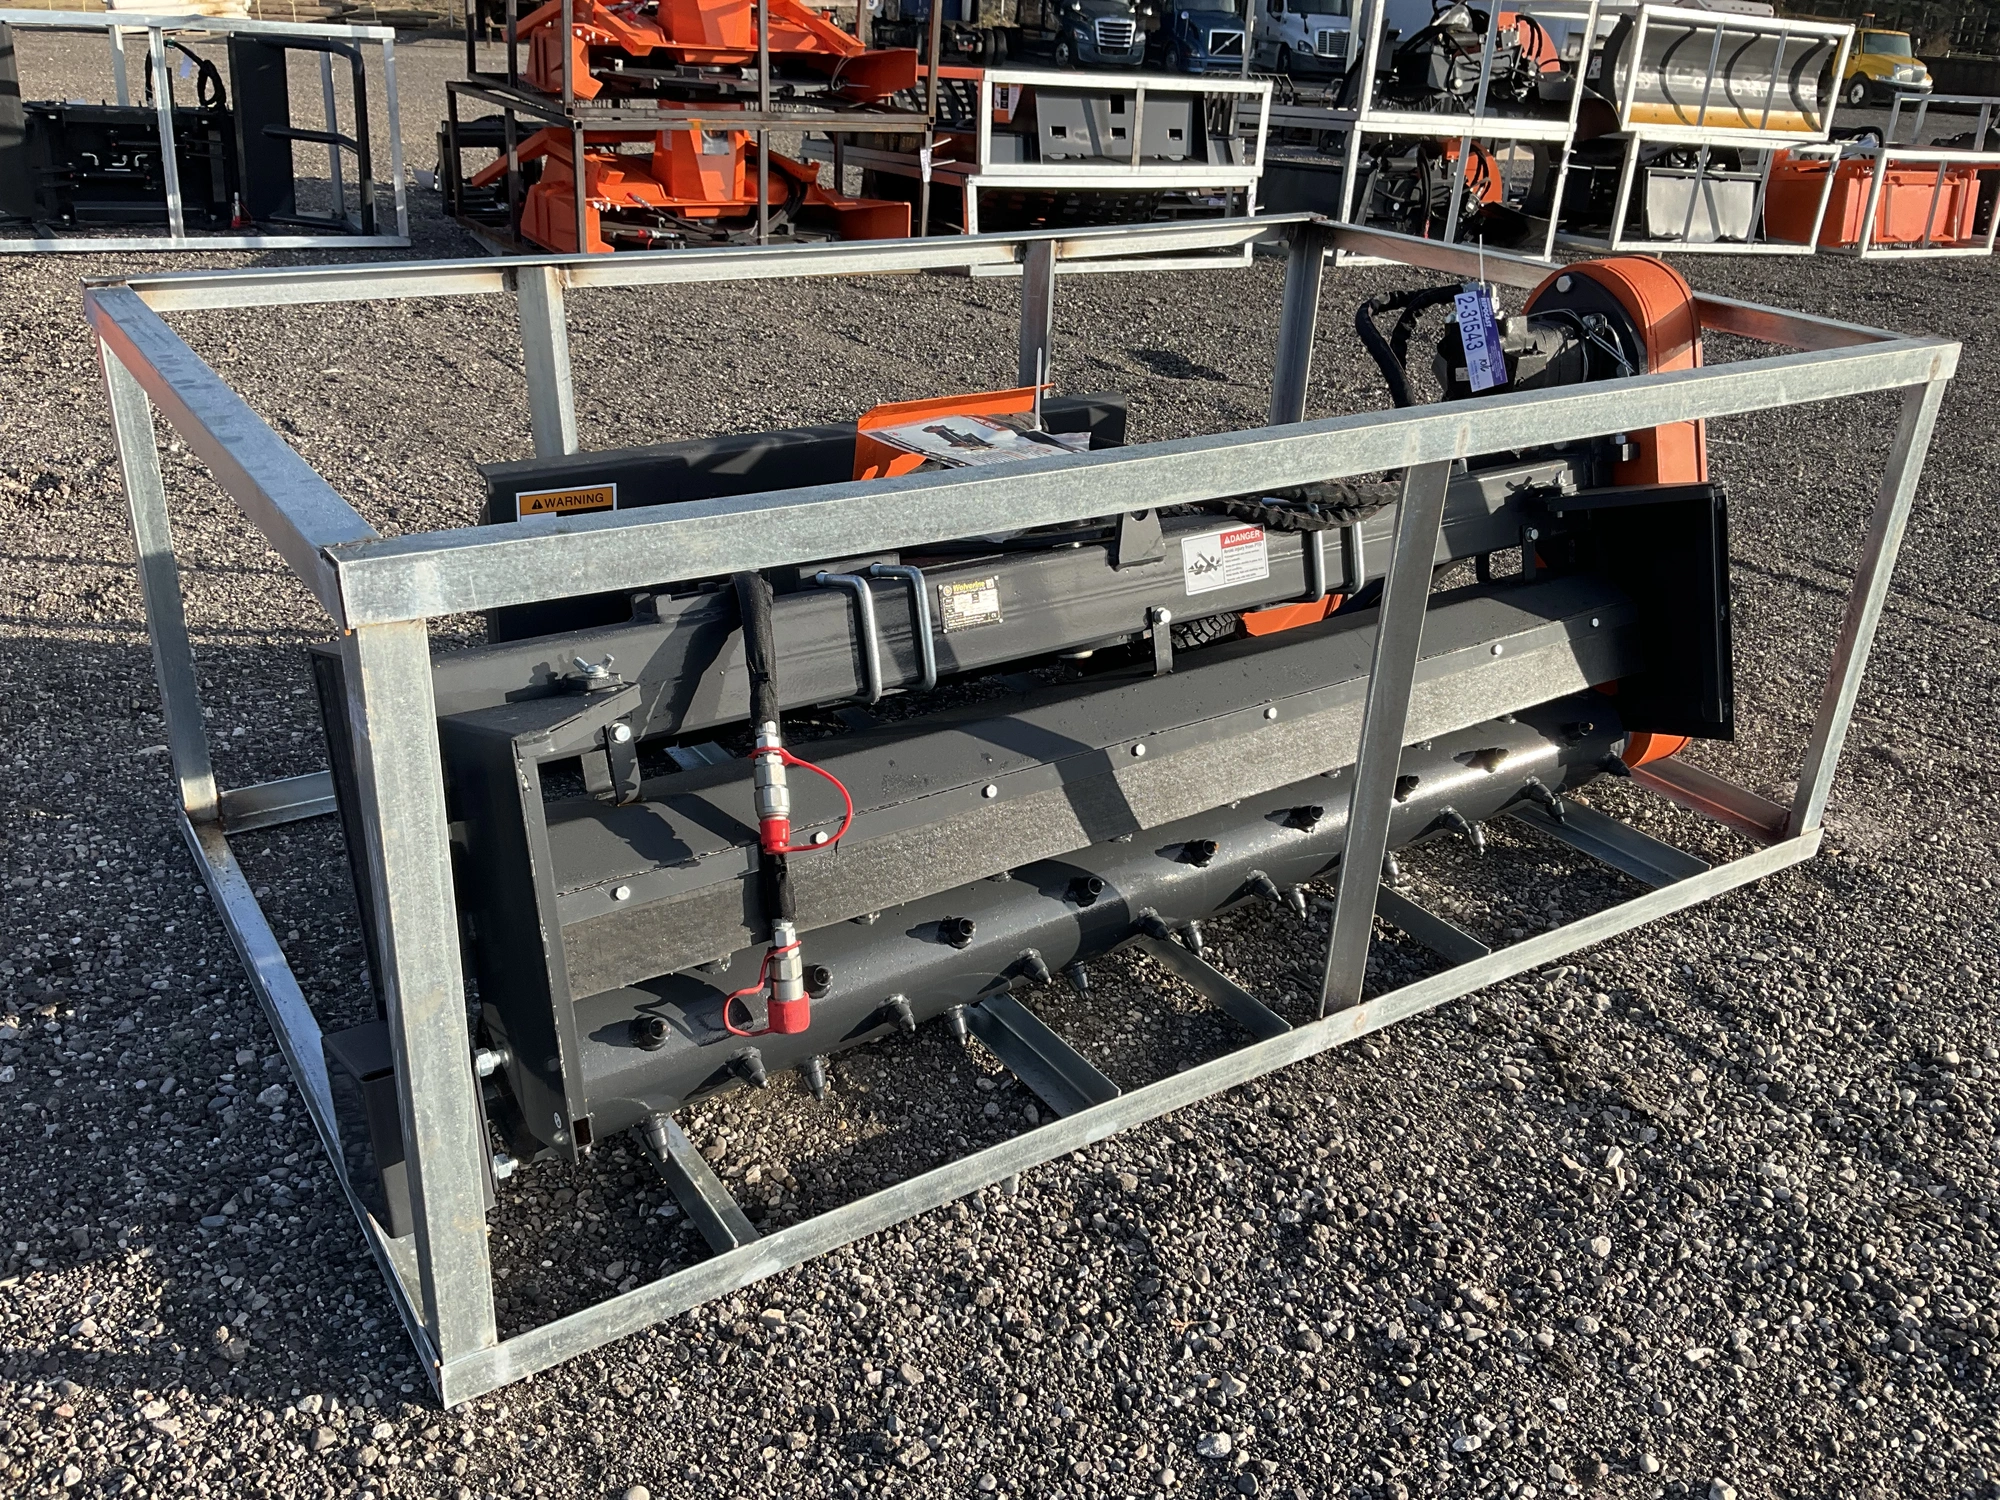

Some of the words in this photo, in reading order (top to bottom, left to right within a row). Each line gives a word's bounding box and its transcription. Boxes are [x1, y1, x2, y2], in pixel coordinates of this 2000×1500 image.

[1458, 296, 1484, 351] 2-31543
[544, 492, 604, 508] WARNING
[1230, 530, 1261, 543] DANGER
[953, 581, 985, 591] Wolverine
